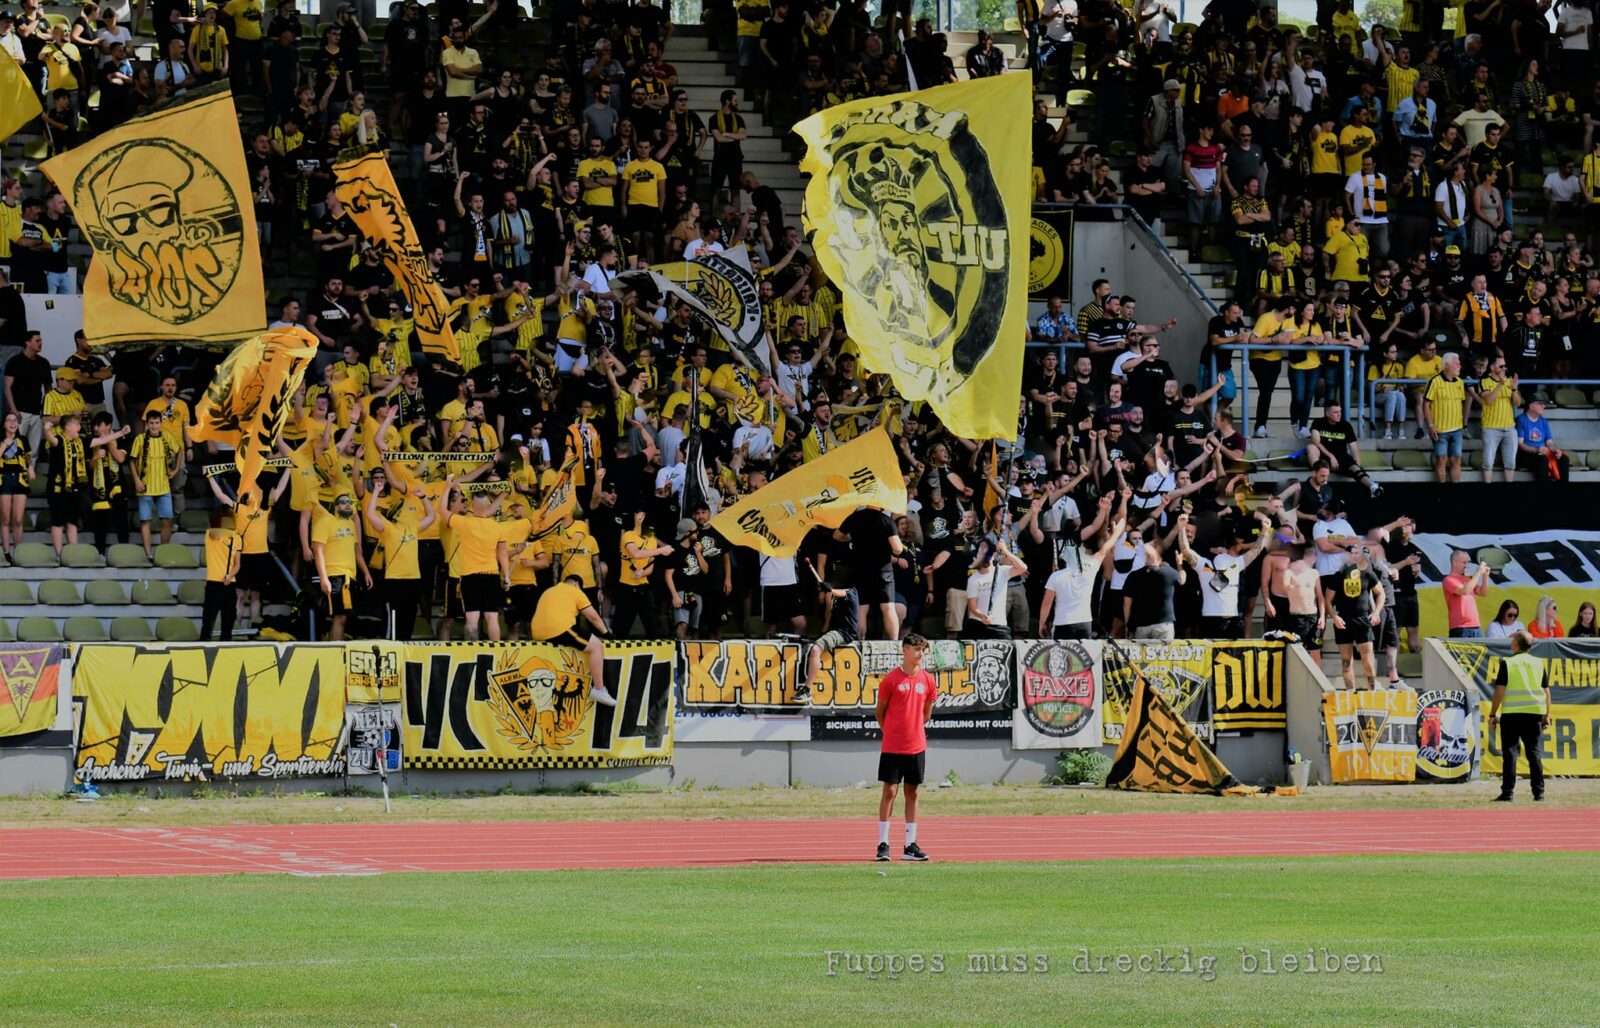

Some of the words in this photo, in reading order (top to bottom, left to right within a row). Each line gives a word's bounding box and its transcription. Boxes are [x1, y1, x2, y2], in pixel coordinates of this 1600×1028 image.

[1031, 219, 1057, 240] AGLES
[384, 452, 424, 461] YELLOW
[428, 452, 496, 461] CONNECTION
[1145, 643, 1205, 660] STADT
[1028, 677, 1091, 698] FAXE
[1043, 703, 1074, 713] POLICE
[352, 710, 395, 731] NEIN
[826, 721, 862, 729] SICHERE
[976, 719, 990, 728] MIT
[75, 757, 150, 780] Aachener
[223, 754, 252, 776] und
[258, 753, 345, 779] Sportverein
